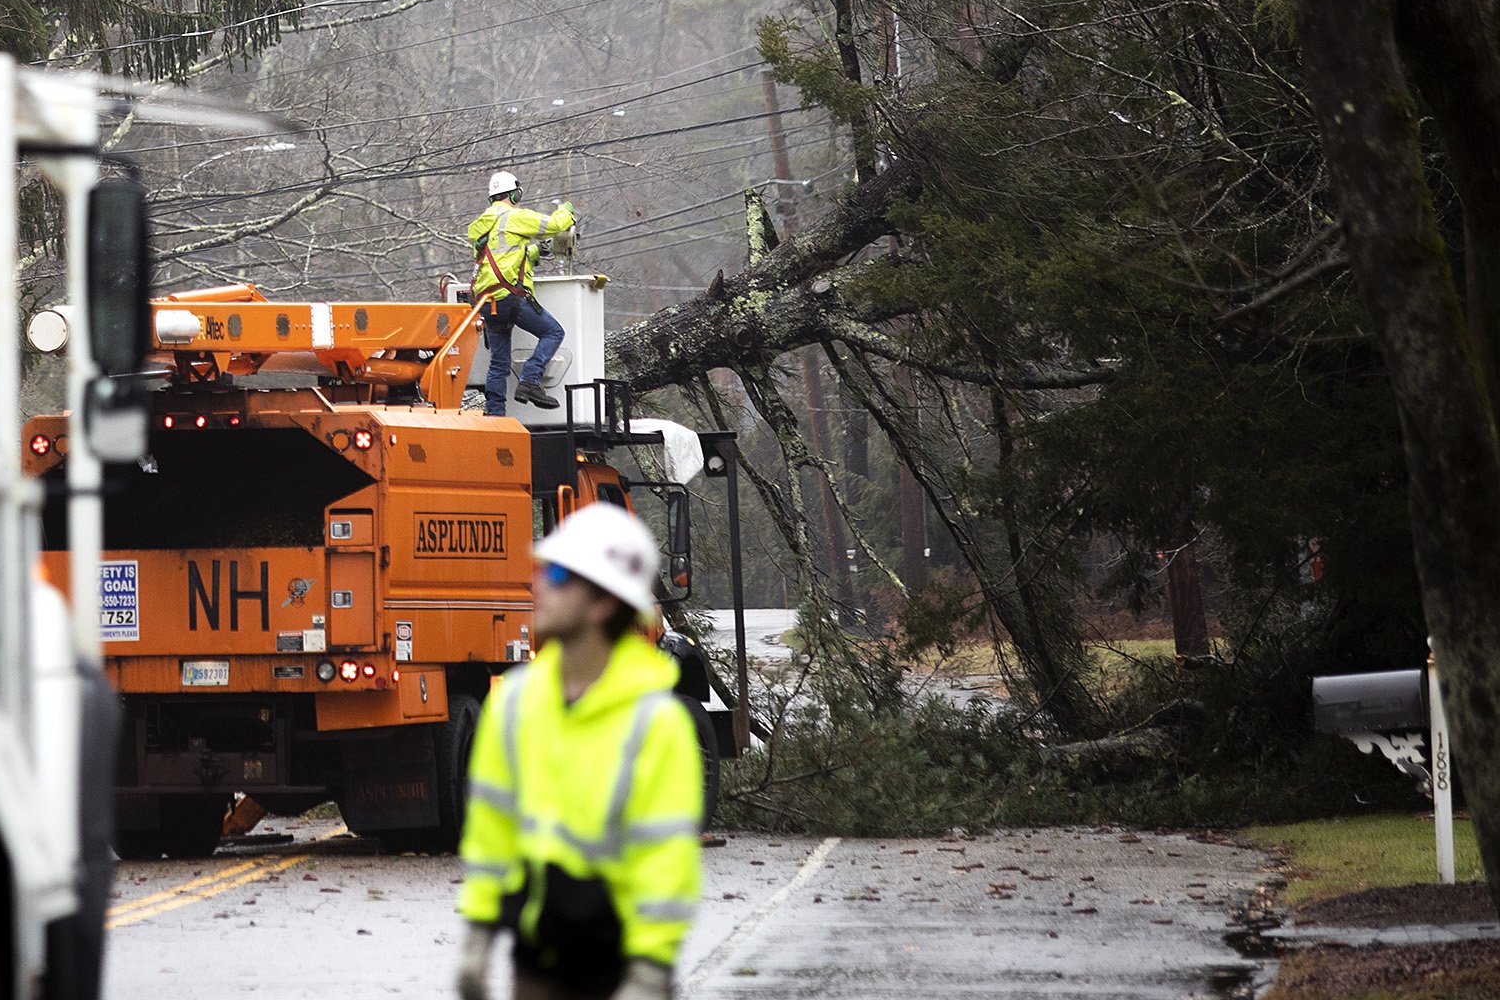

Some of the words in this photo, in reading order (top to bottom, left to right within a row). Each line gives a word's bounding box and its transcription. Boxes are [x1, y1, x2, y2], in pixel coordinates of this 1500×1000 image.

[206, 315, 225, 340] Altec
[416, 519, 504, 553] ASPLUNDH
[104, 580, 135, 592] GOAL
[125, 566, 135, 578] IS
[188, 560, 269, 632] NH
[1437, 731, 1447, 790] 188
